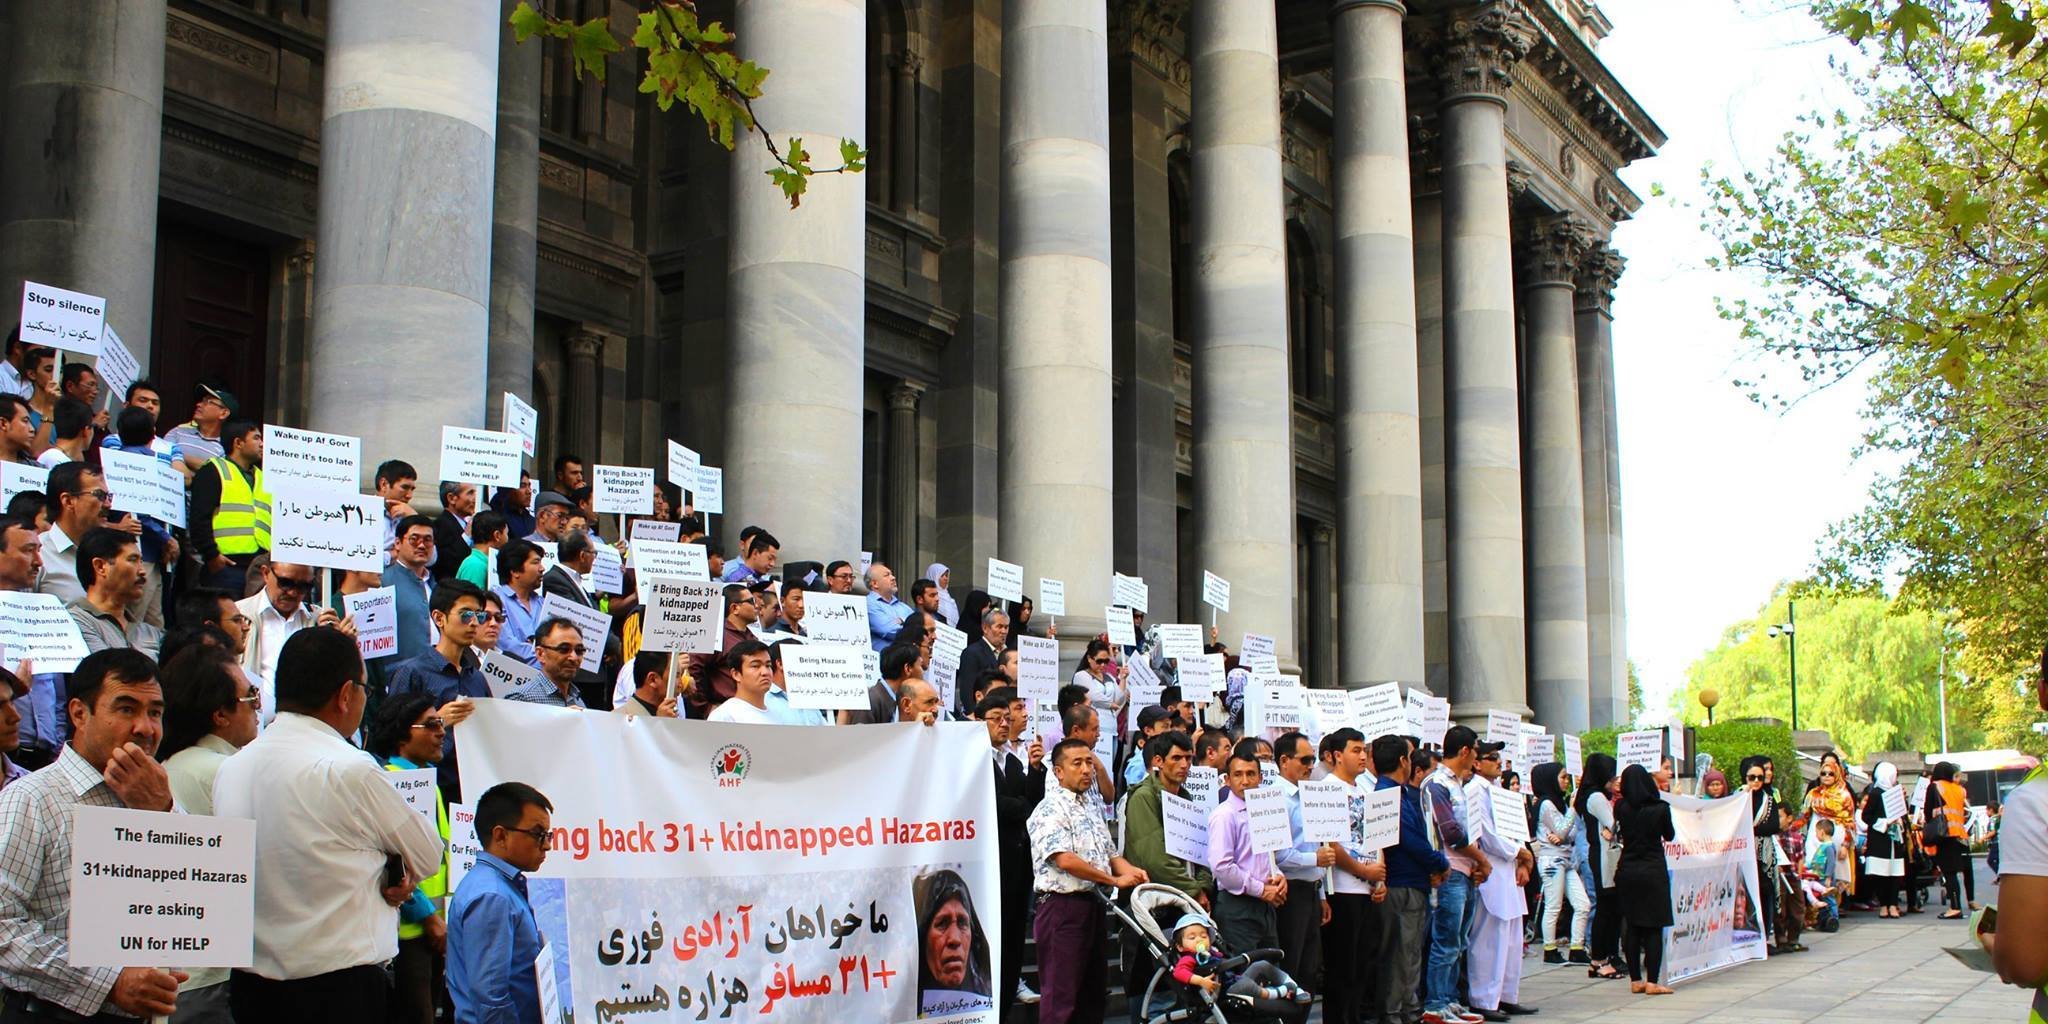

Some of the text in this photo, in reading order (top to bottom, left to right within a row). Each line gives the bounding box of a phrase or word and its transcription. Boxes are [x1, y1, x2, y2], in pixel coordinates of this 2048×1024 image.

[28, 292, 101, 315] Stop silence
[274, 430, 298, 440] Wake
[329, 438, 350, 448] Govt
[270, 448, 299, 459] before
[319, 456, 333, 464] too
[335, 458, 353, 466] late
[492, 450, 518, 458] Hazaras
[476, 461, 498, 469] asking
[19, 477, 41, 487] Being
[604, 478, 645, 486] kidnapped
[279, 501, 288, 516] را
[292, 502, 301, 514] ما
[278, 537, 376, 558] قربانی سیاست نکنید
[661, 558, 691, 566] kidnapped
[660, 584, 681, 597] Bring
[683, 586, 703, 597] Back
[705, 588, 718, 597] 31+
[354, 596, 392, 611] Deportation
[659, 598, 709, 613] kidnapped
[663, 611, 702, 623] Hazaras
[364, 640, 371, 652] IT
[373, 636, 394, 650] NOW!!
[1045, 642, 1055, 650] Govt
[799, 656, 819, 665] Being
[485, 662, 512, 682] Stop
[1409, 696, 1423, 708] Stop
[720, 778, 741, 787] AHF
[1183, 782, 1209, 791] napped
[456, 812, 474, 823] STOP
[114, 827, 222, 847] The families of
[470, 831, 475, 839] &
[598, 817, 656, 855] back
[662, 822, 715, 853] 31+
[719, 817, 874, 856] kidnapped
[881, 816, 976, 845] Hazaras
[452, 844, 463, 854] Our
[83, 862, 248, 884] 31+kidnapped Hazaras
[128, 903, 205, 920] are asking
[597, 899, 889, 966] ما خواهان آزادی فوری
[120, 936, 210, 950] UN for HELP
[758, 963, 833, 1015] مسافر
[594, 983, 670, 1024] هستیم
[677, 970, 750, 1023] هزاره
